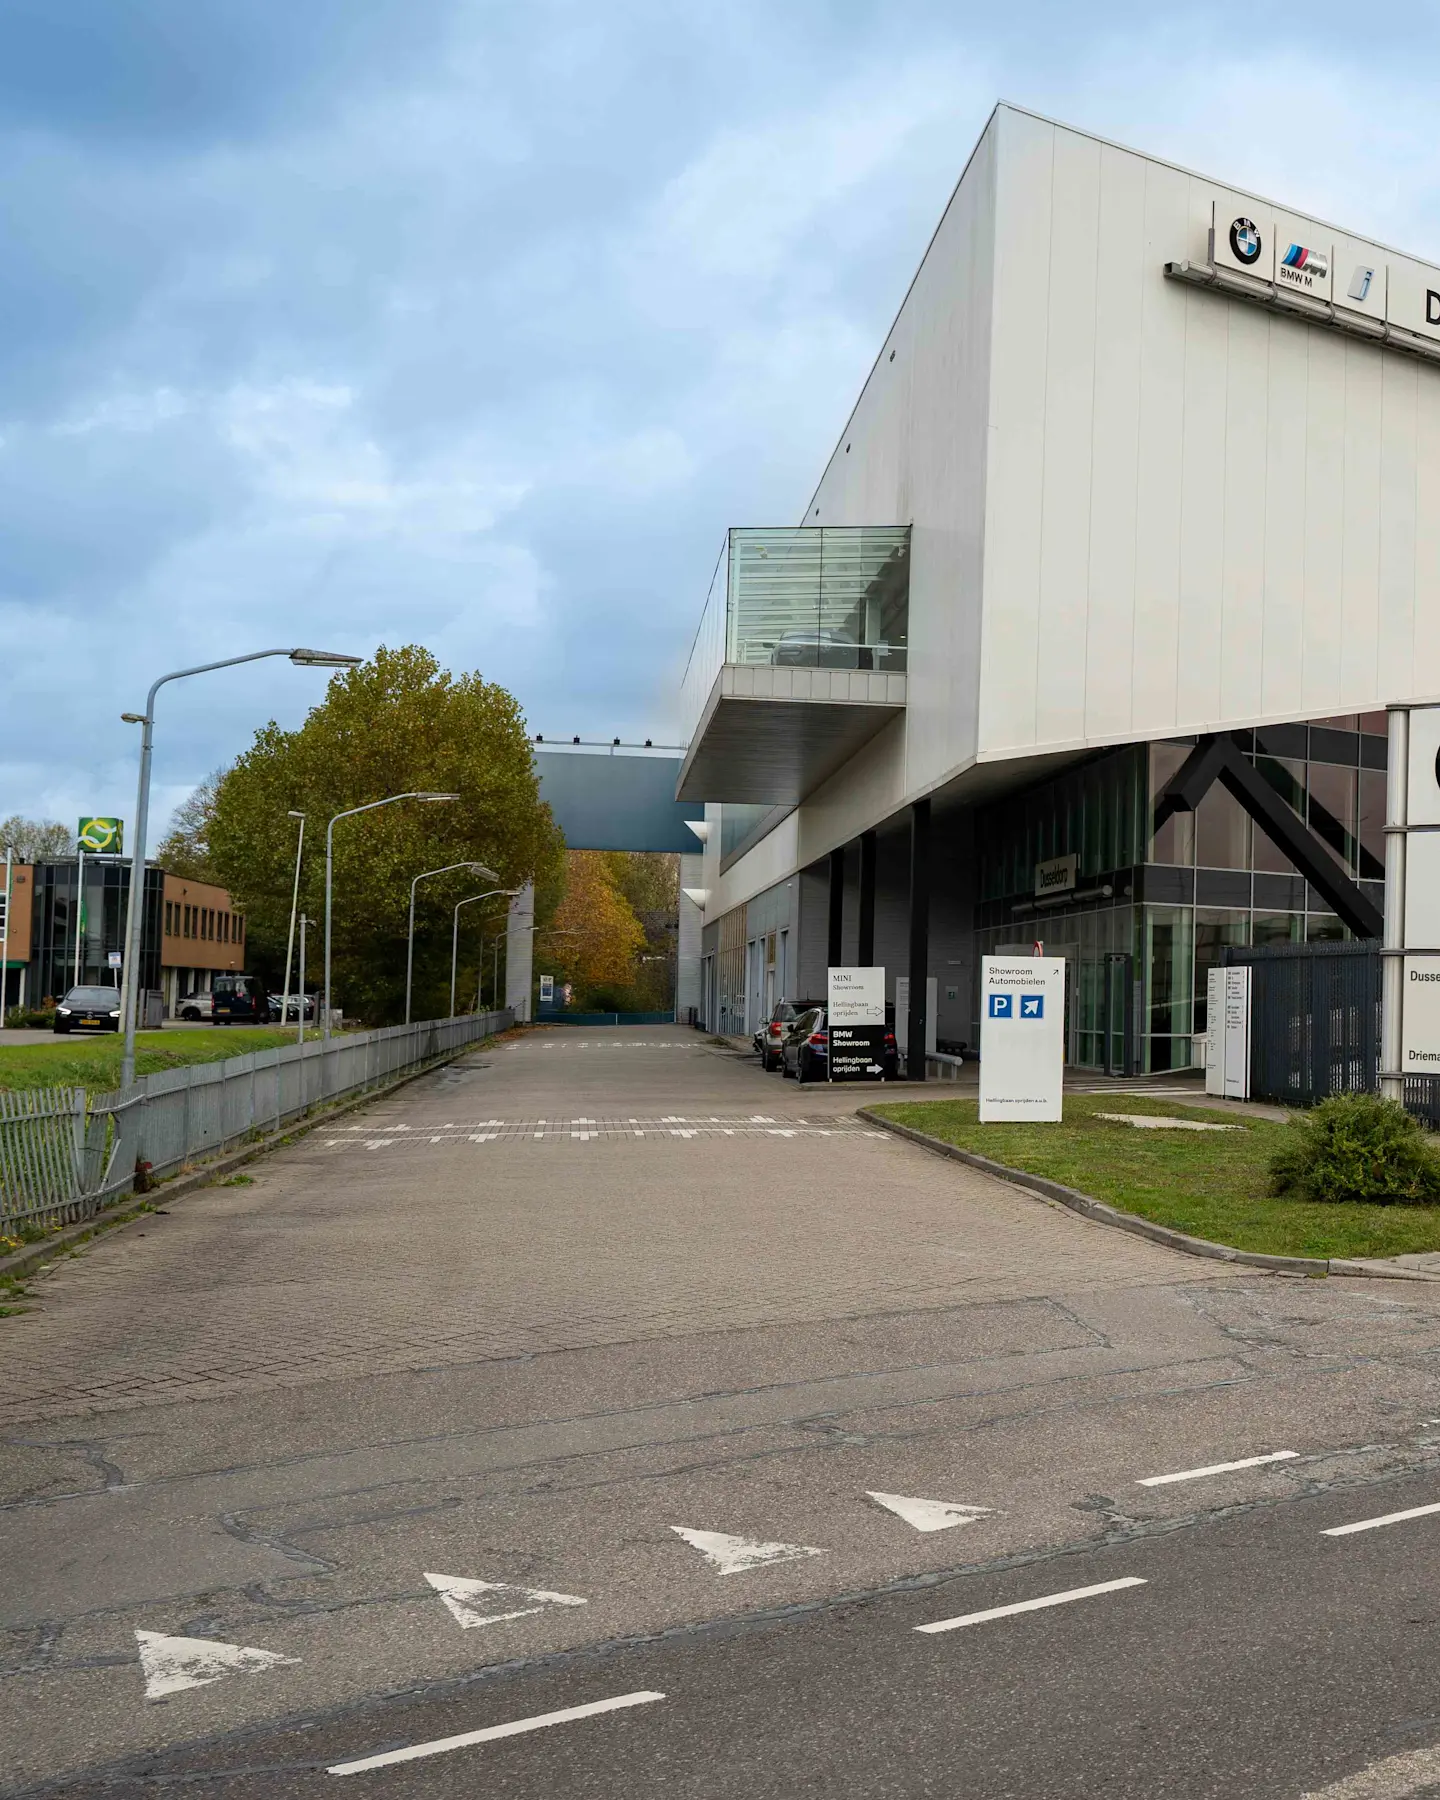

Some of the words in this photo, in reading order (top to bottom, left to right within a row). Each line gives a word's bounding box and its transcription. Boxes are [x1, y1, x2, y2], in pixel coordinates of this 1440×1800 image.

[1281, 267, 1303, 285] BMW
[1304, 277, 1313, 288] M
[1040, 863, 1068, 889] Dusseldorp
[988, 966, 1033, 975] Showroom
[833, 974, 852, 982] MINI
[988, 977, 1046, 986] Automobielen
[832, 1001, 869, 1009] Hellingbaan
[993, 996, 1008, 1017] P
[832, 1010, 859, 1018] oprijden
[832, 1030, 853, 1038] BMW
[832, 1039, 870, 1047] Showroom
[832, 1056, 873, 1065] Hellingbaan
[832, 1065, 861, 1073] oprijden
